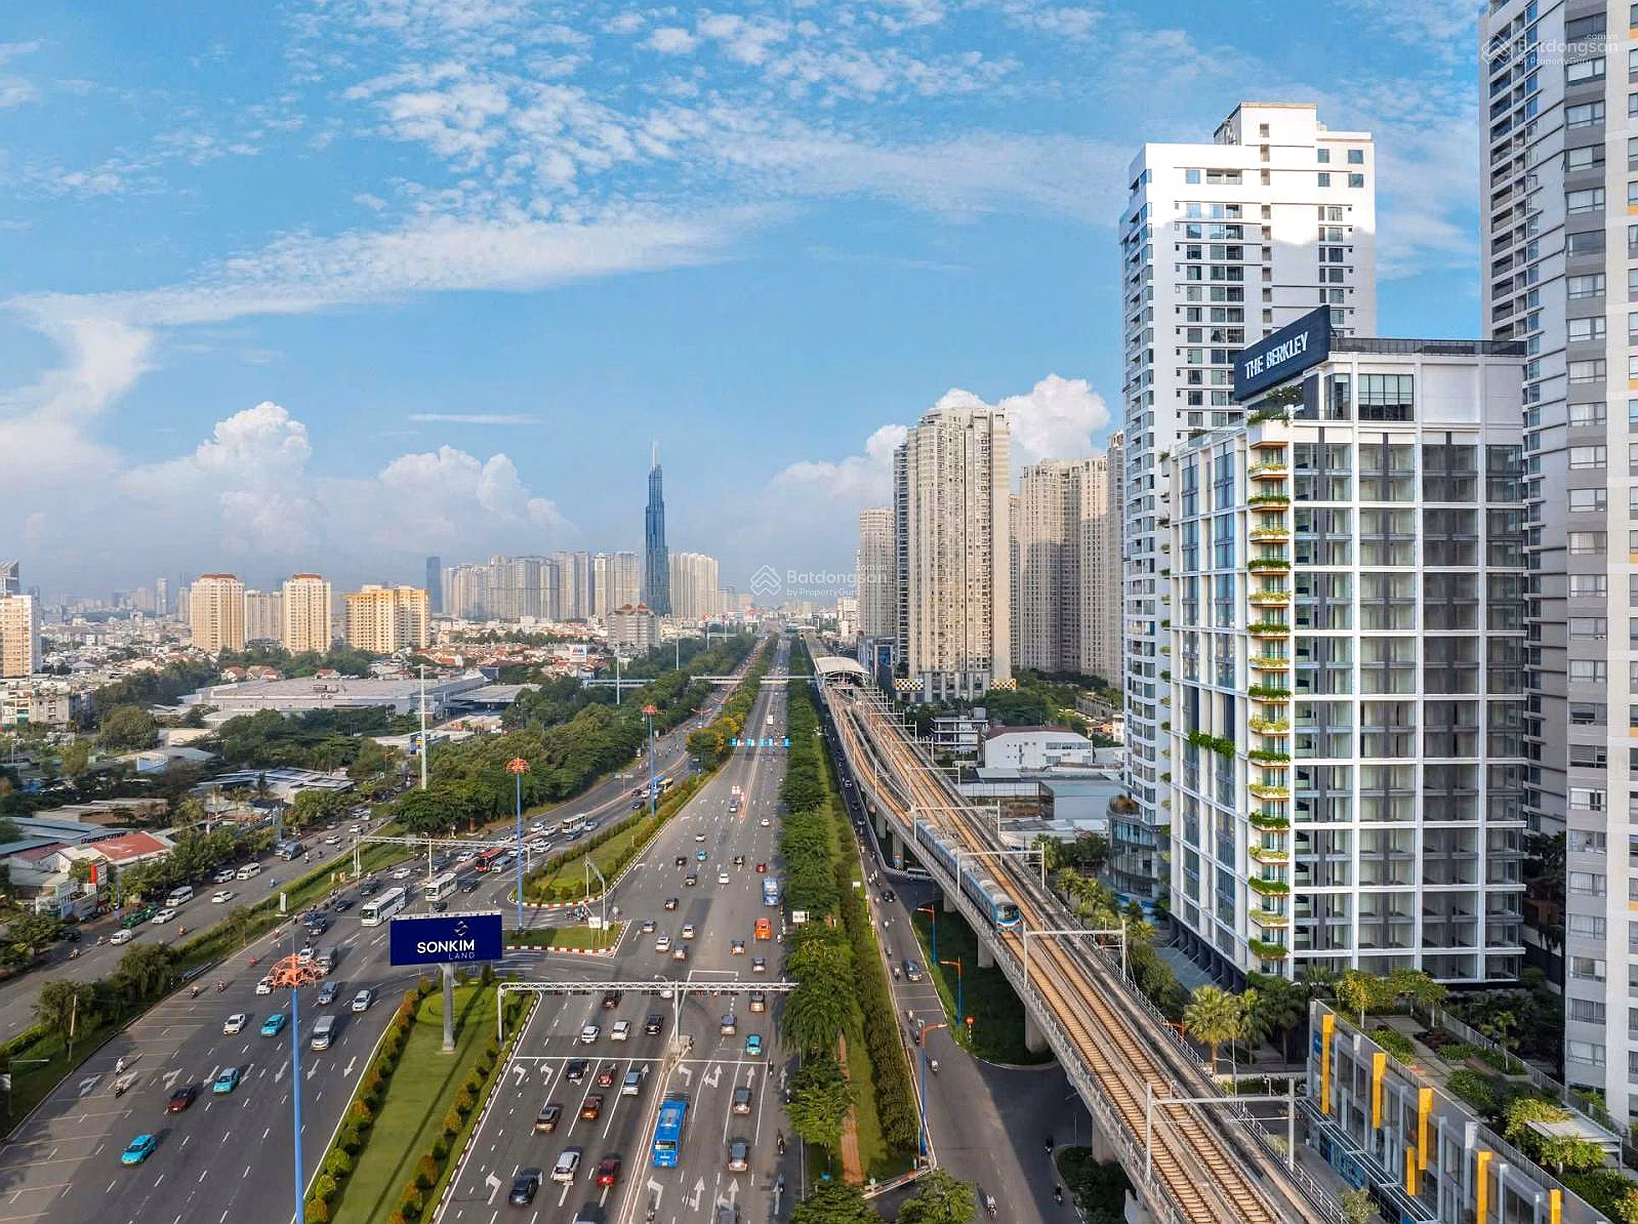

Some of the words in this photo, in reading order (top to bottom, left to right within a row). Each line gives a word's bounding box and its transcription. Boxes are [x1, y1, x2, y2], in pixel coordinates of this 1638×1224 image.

[1244, 355, 1264, 379] THE
[1266, 331, 1309, 369] BERKLEY
[417, 939, 475, 954] SONKIM
[448, 952, 475, 960] LAND
